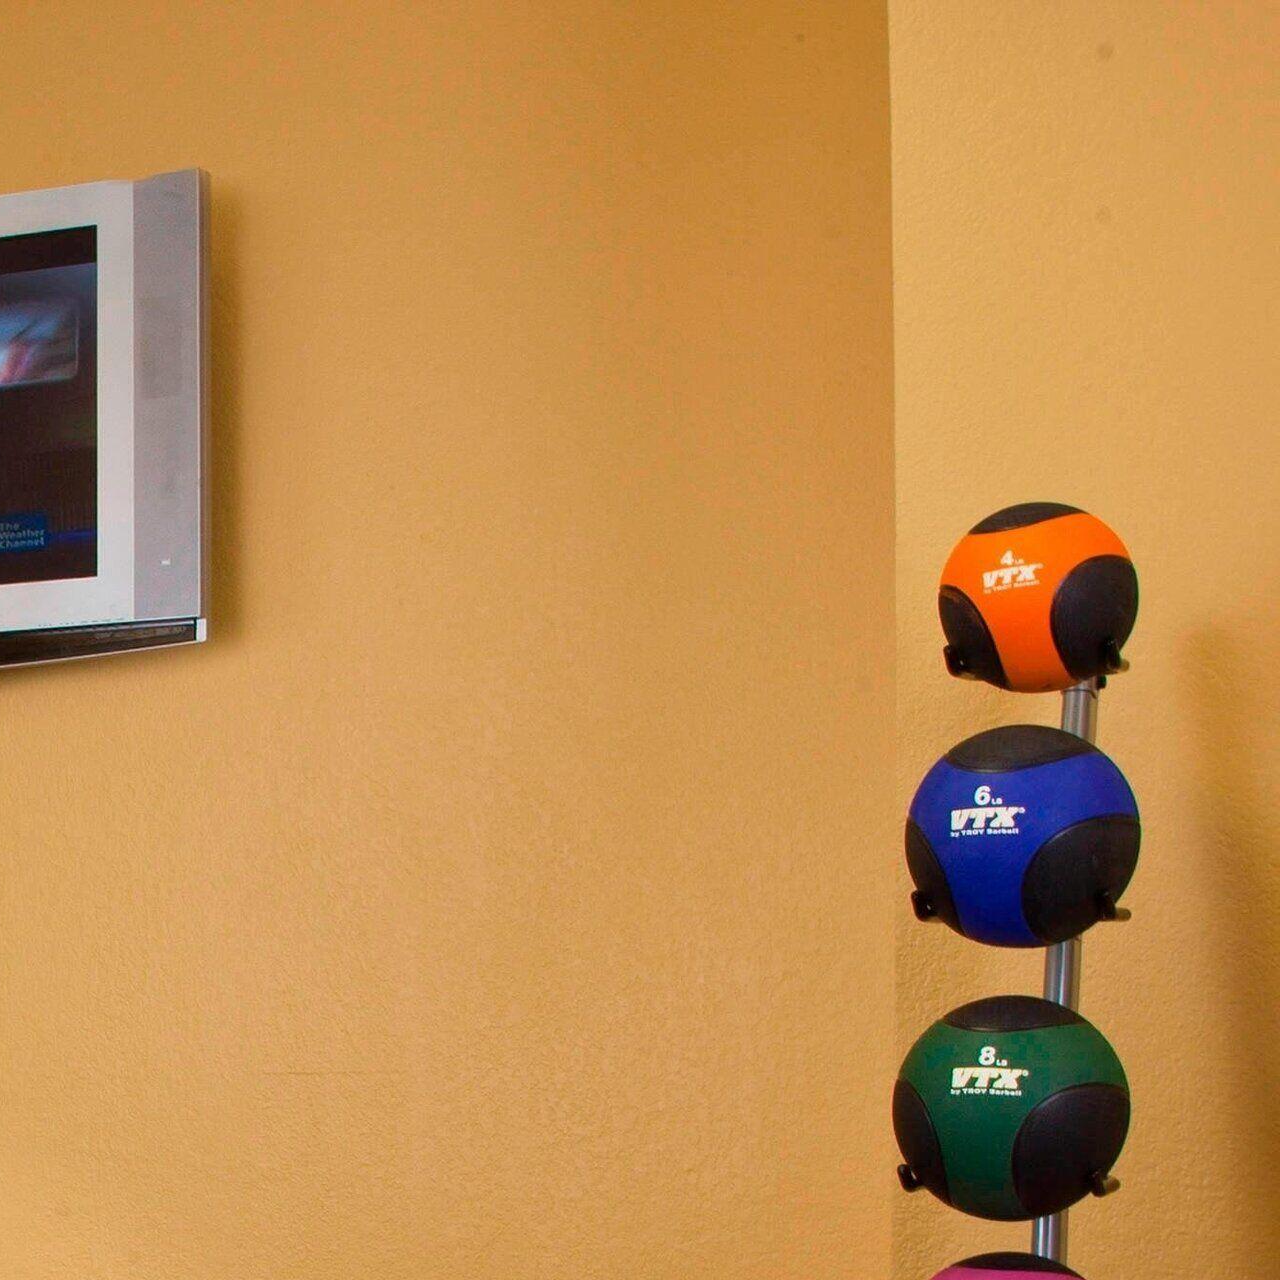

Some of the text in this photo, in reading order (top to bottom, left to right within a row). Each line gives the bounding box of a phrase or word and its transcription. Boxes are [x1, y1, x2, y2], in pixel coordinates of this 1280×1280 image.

[1000, 549, 1014, 566] 4
[974, 785, 991, 806] 6
[978, 1046, 996, 1066] 8
